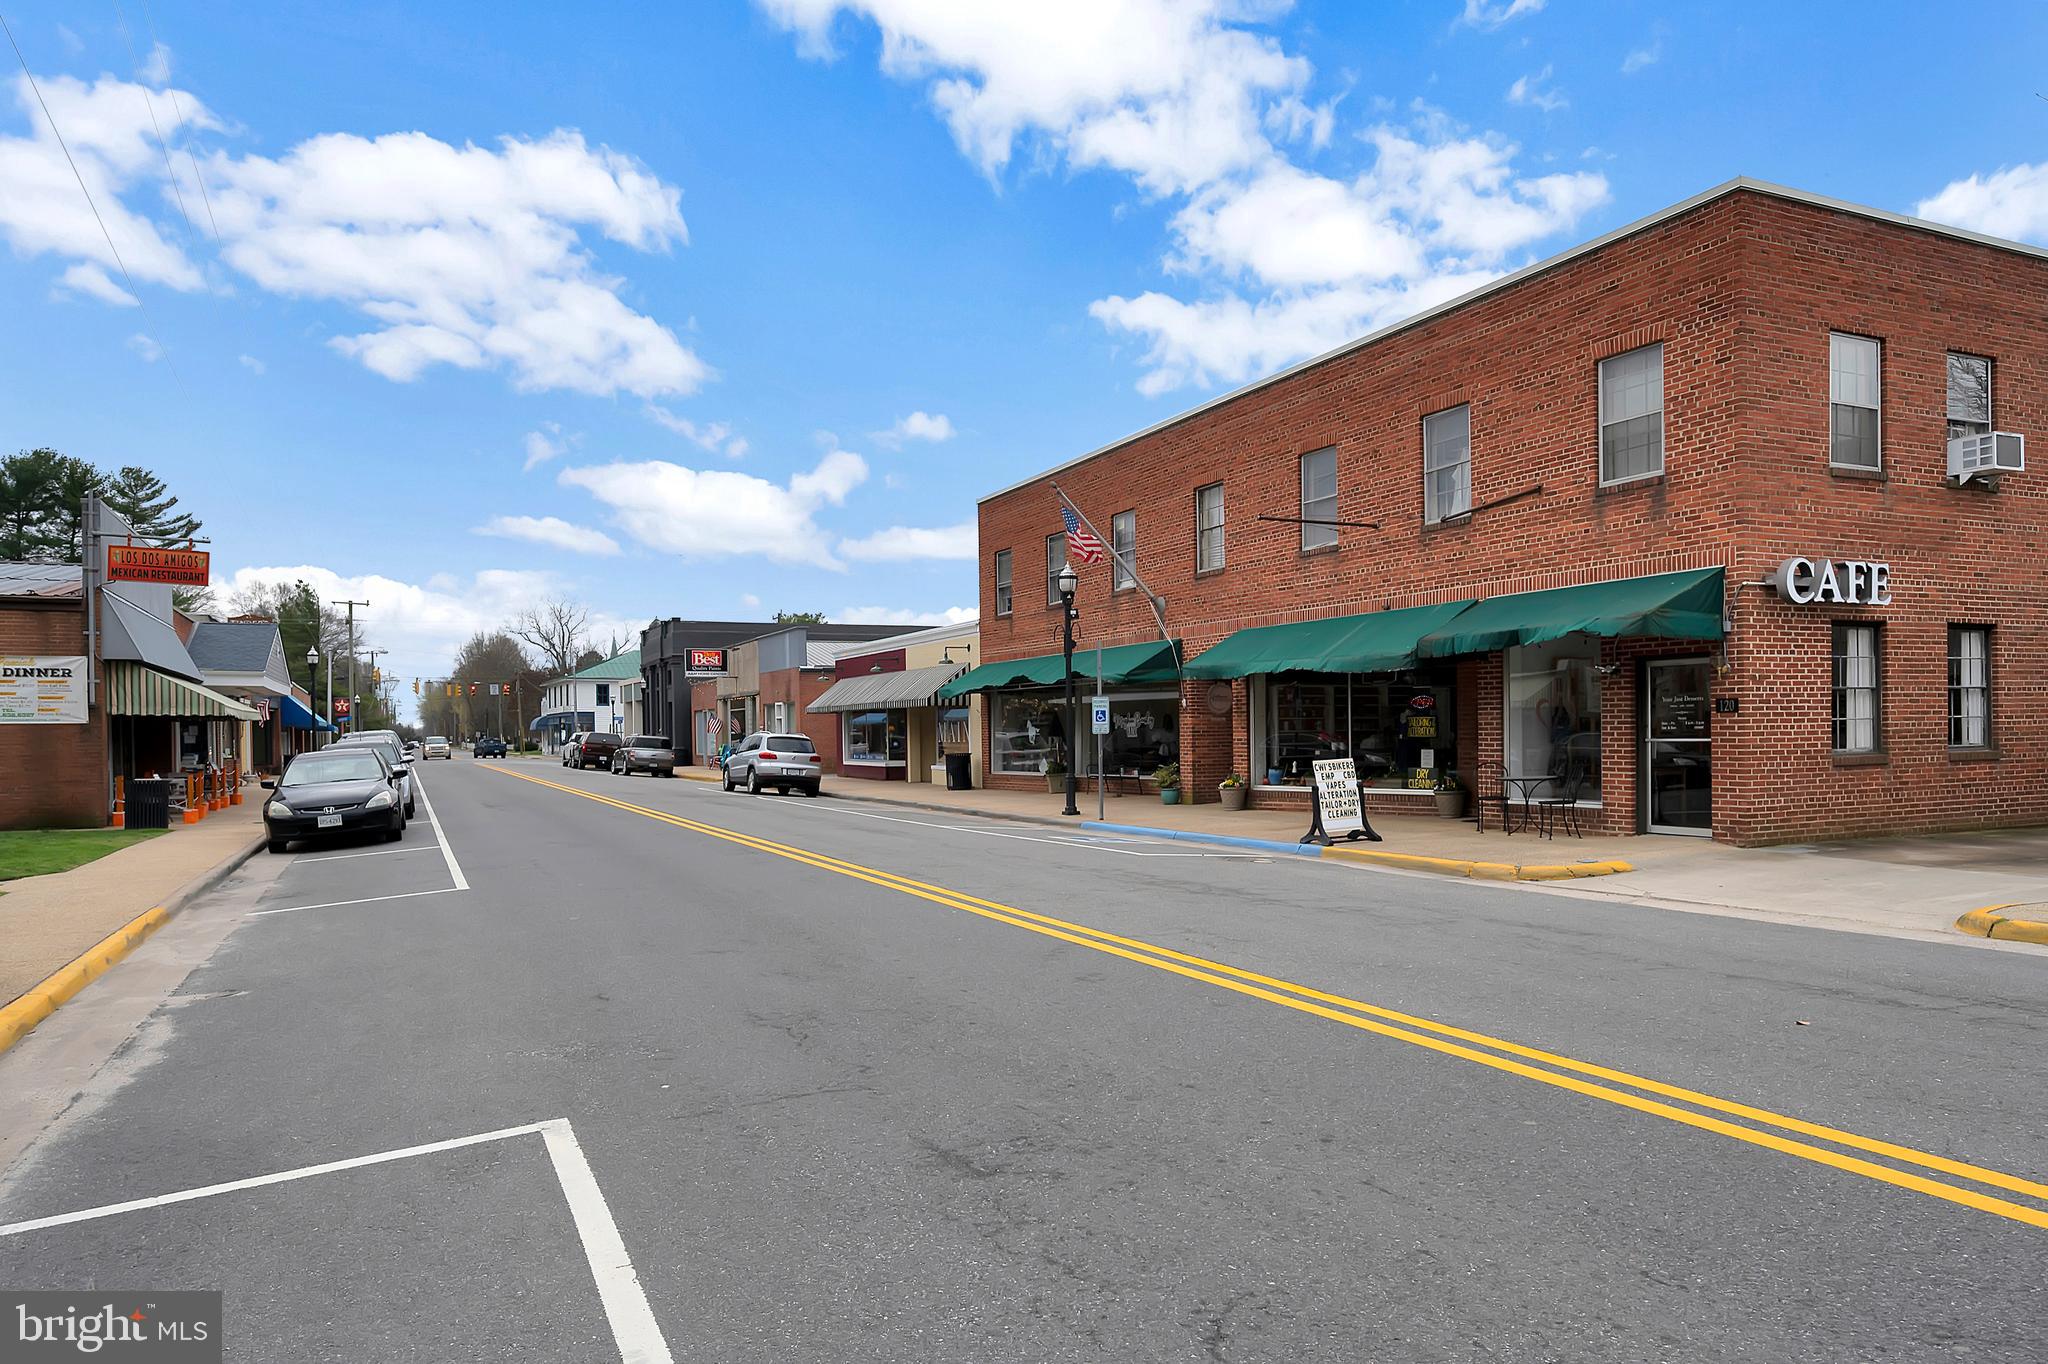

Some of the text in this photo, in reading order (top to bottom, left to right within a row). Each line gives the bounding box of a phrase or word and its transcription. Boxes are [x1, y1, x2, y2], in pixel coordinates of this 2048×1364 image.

[121, 550, 199, 568] LOS DOS AMIGOS
[111, 567, 205, 582] MEXICAN RESTAURANT
[1786, 557, 1892, 606] CAFE
[693, 652, 720, 665] Best
[2, 667, 73, 678] DINNER
[1719, 700, 1735, 712] 120
[1320, 770, 1356, 780] EMP CBD
[1416, 768, 1429, 779] DRY
[1325, 781, 1347, 789] VAPES
[1319, 789, 1358, 800] ALTERATION
[1327, 808, 1358, 818] CLEANING
